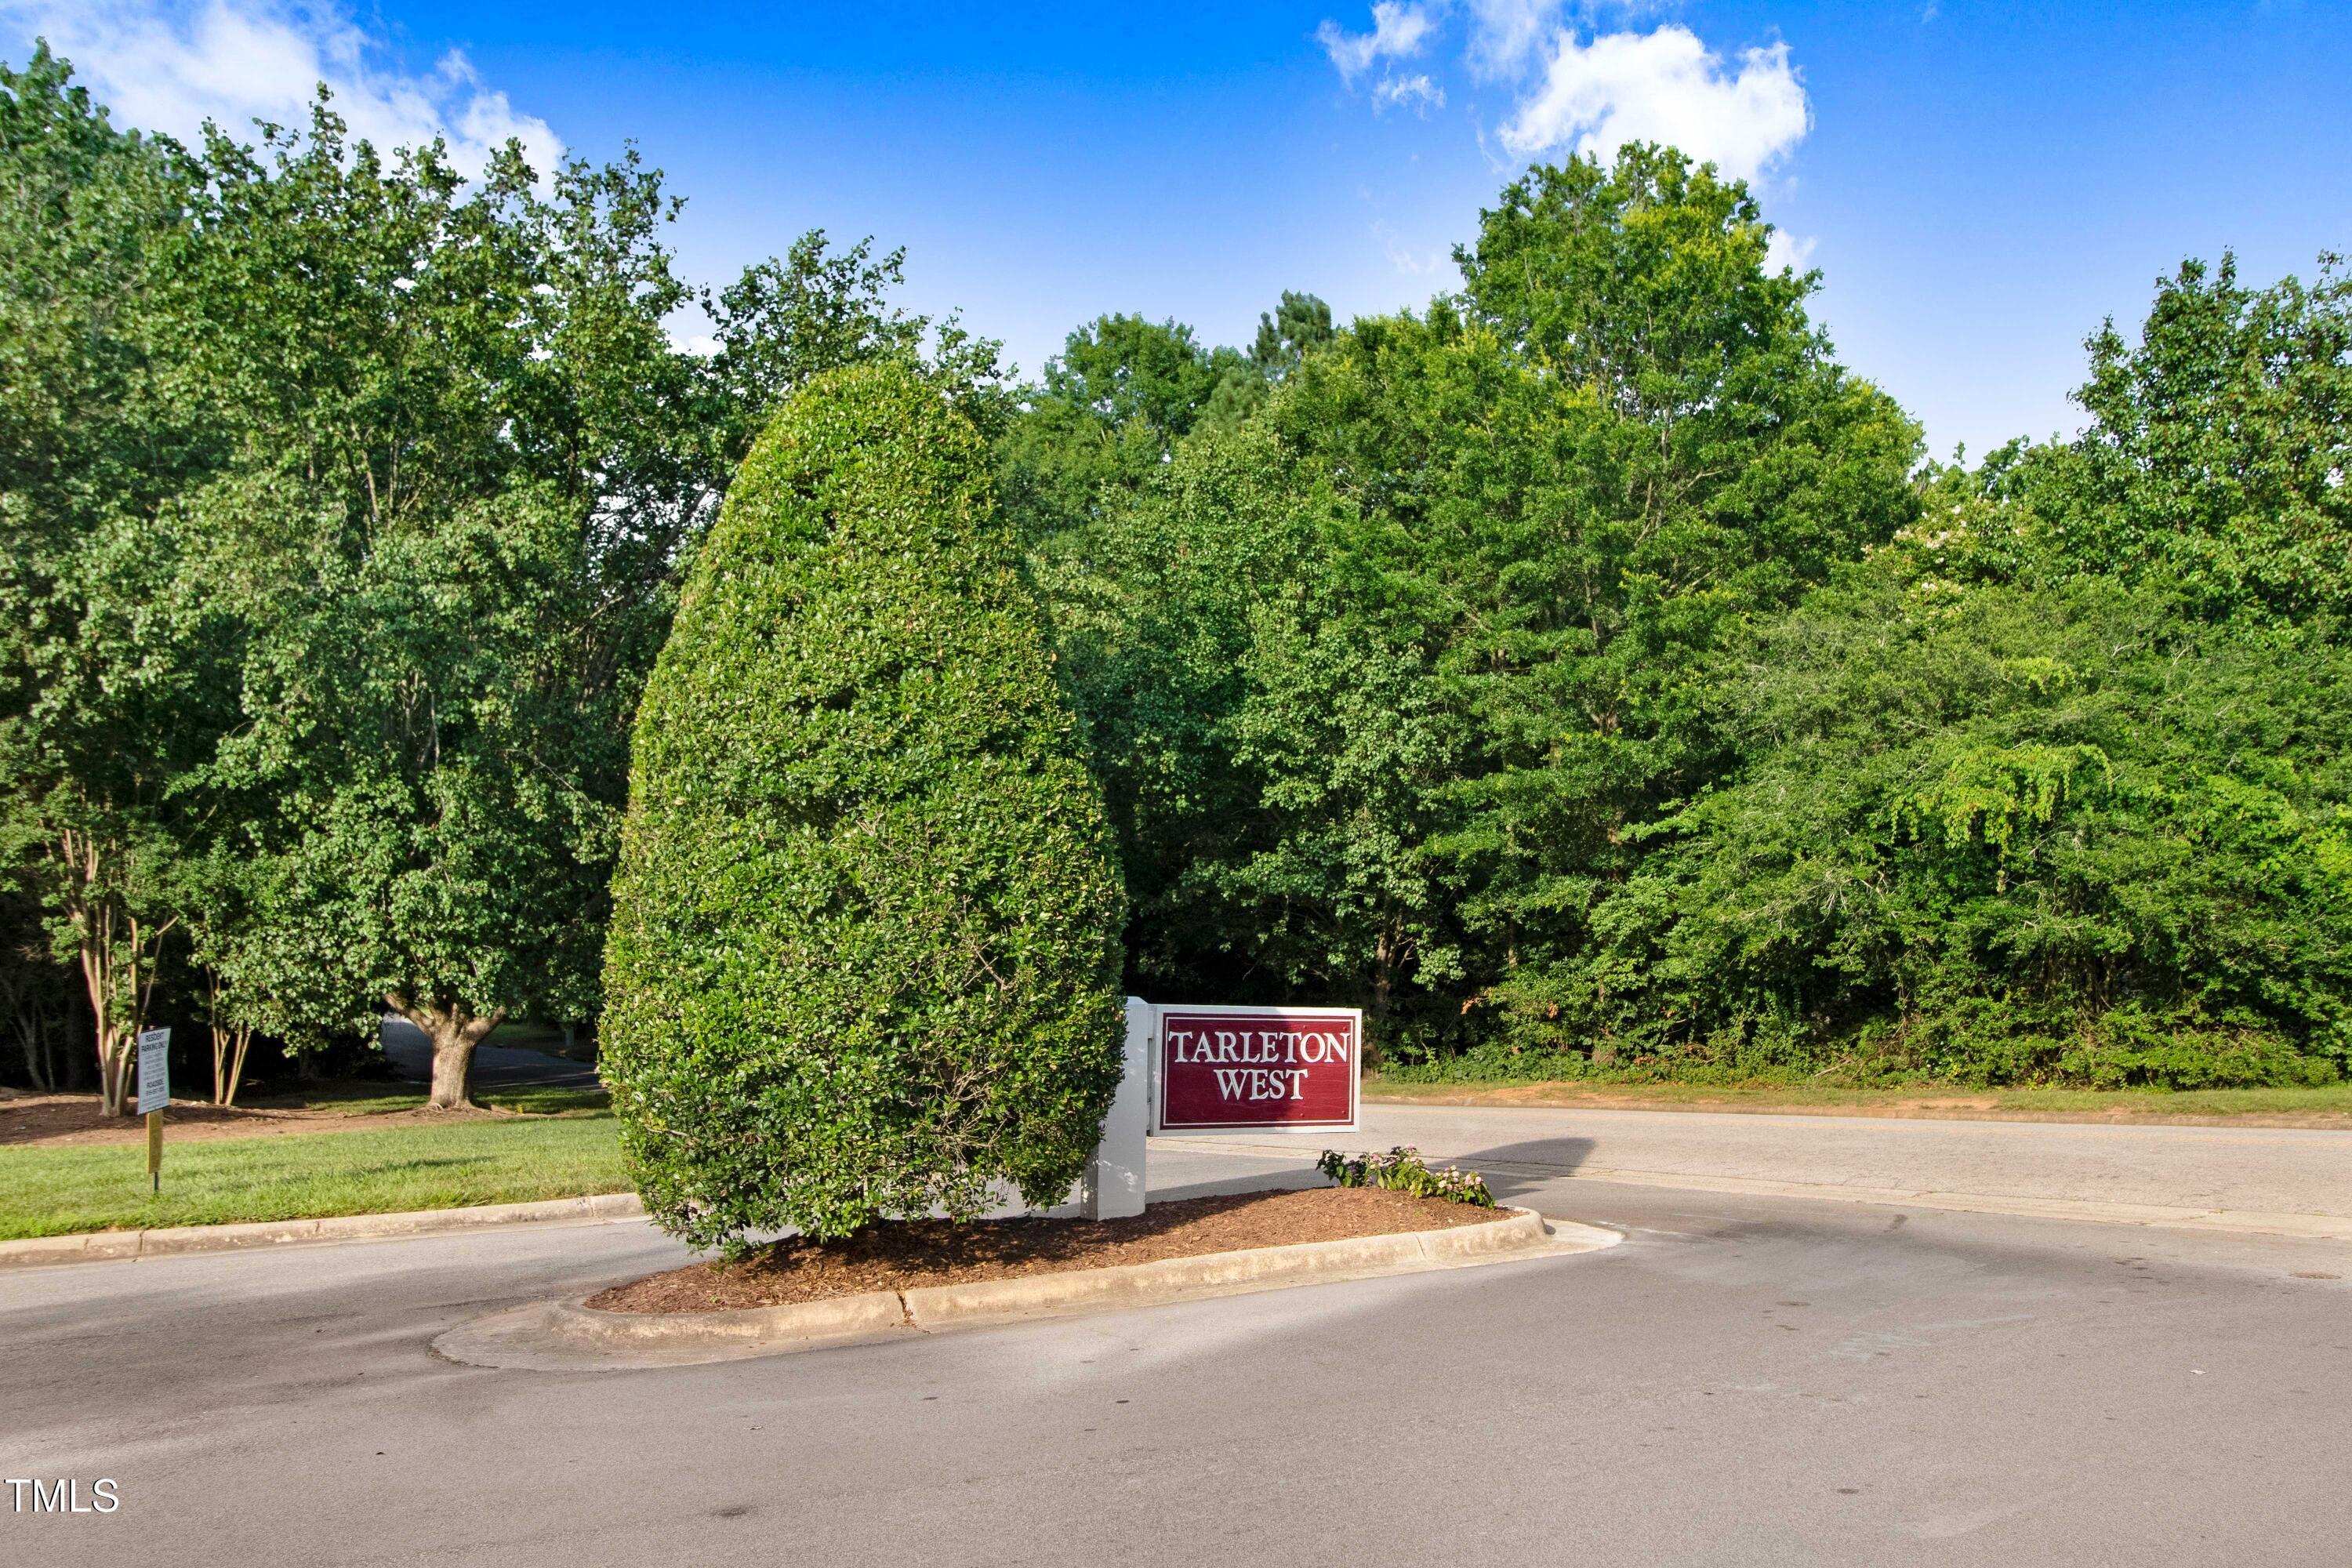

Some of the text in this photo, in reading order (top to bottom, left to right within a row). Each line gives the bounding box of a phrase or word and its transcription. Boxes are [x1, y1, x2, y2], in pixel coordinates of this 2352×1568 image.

[146, 1032, 165, 1042] RESIDENT
[1168, 1031, 1351, 1063] TARLETON
[1213, 1069, 1308, 1101] WEST
